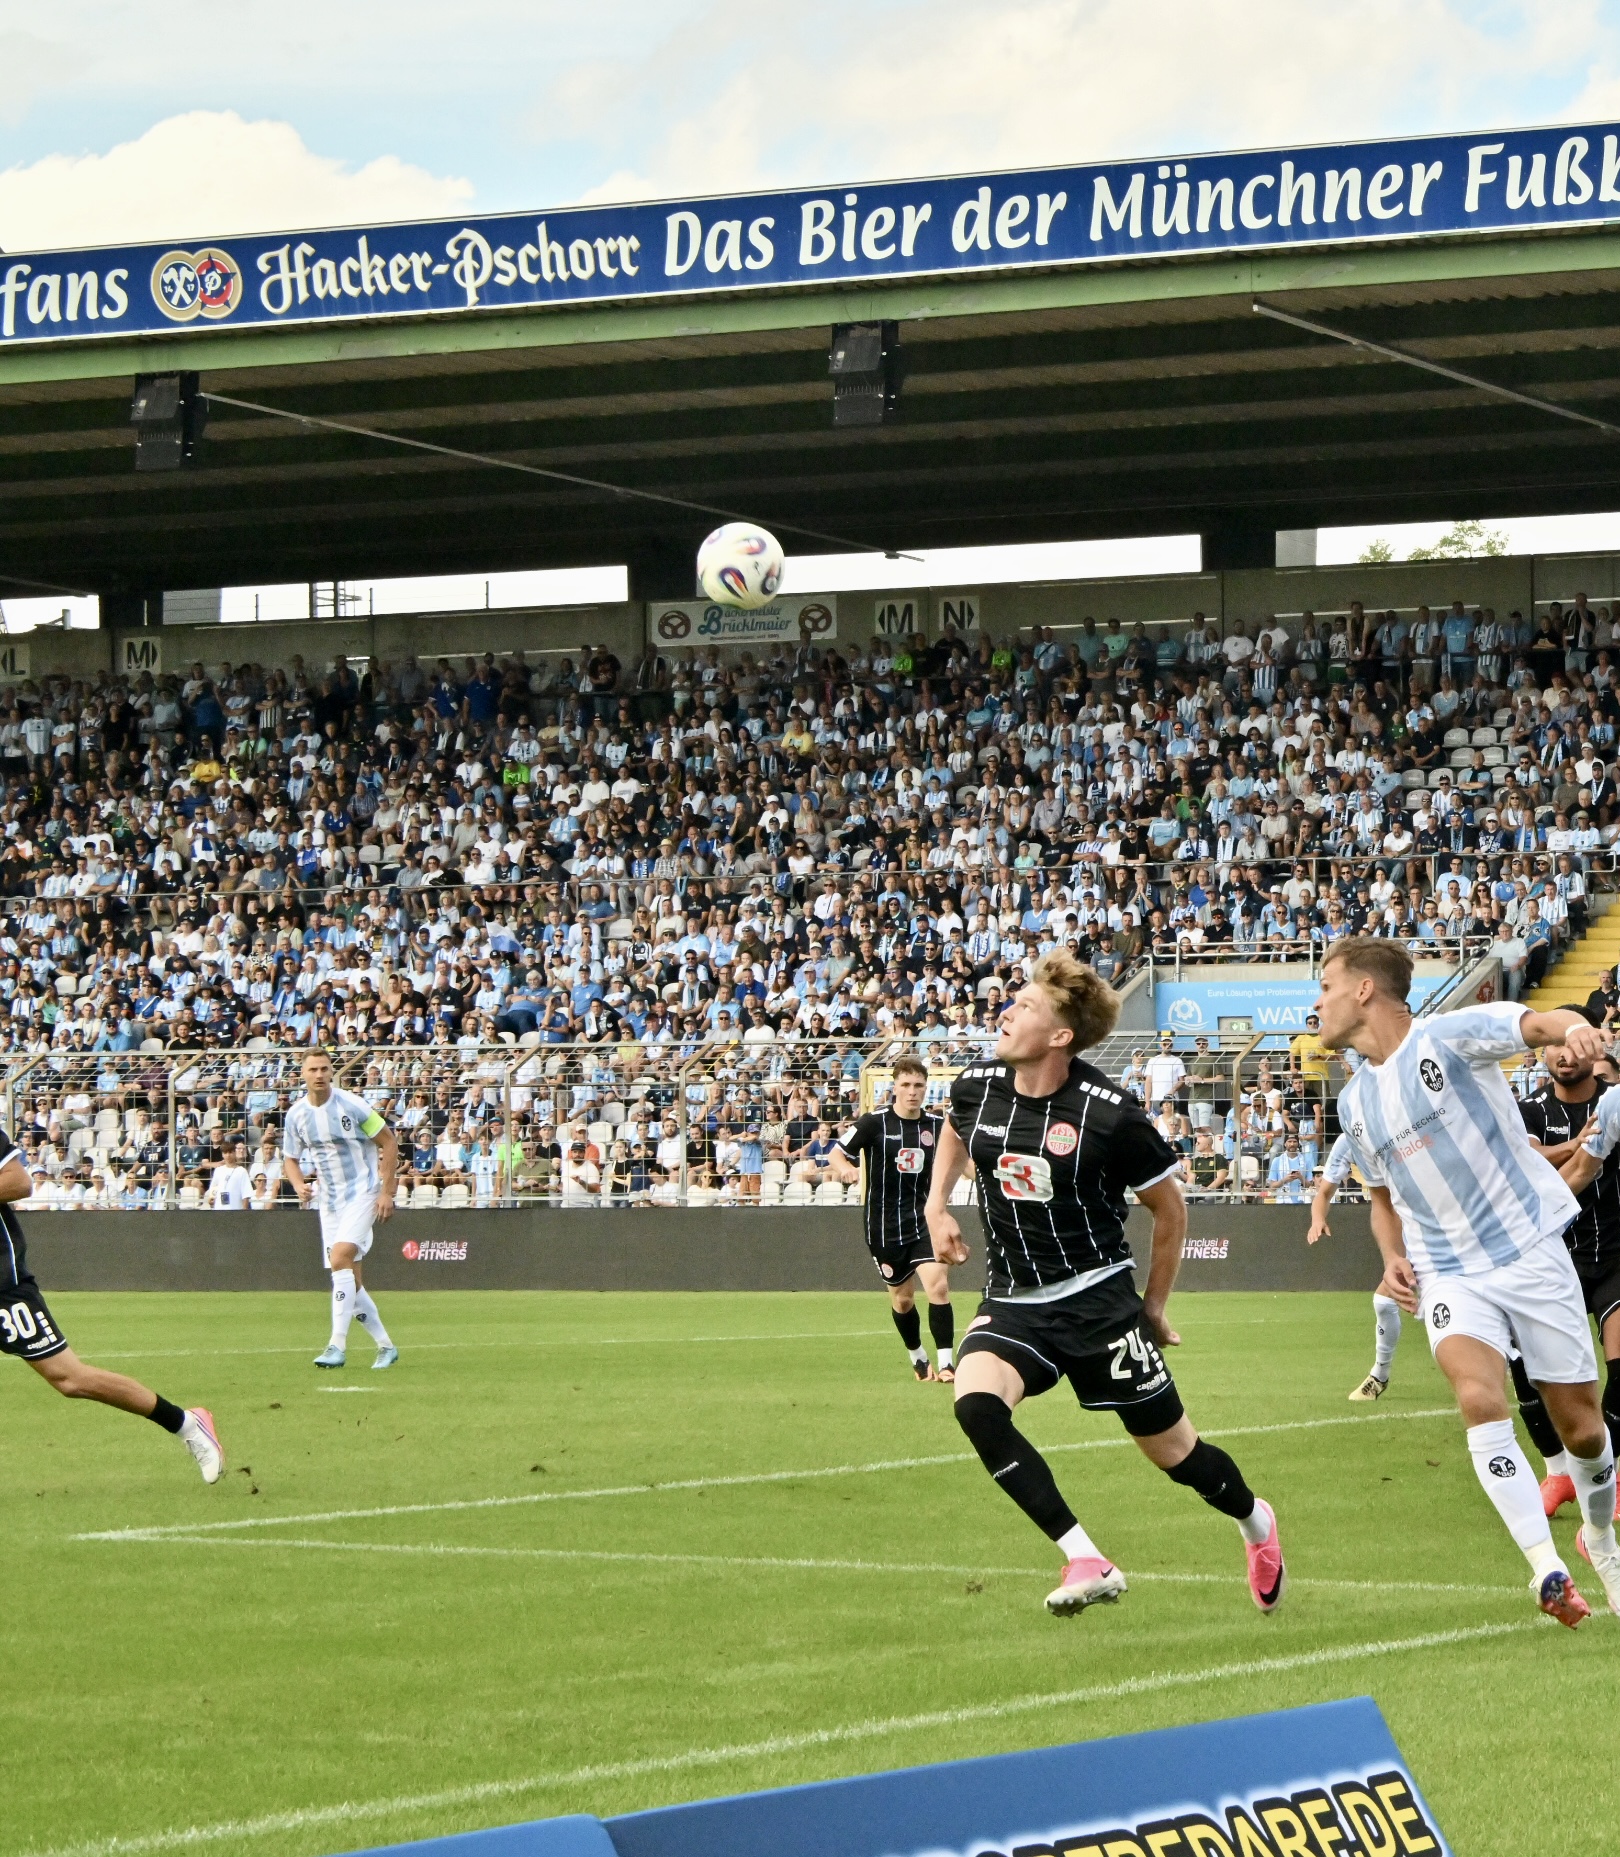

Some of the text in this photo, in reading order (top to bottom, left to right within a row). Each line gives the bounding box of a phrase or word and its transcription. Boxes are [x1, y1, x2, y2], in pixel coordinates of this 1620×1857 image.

[665, 212, 774, 276] Das
[799, 194, 931, 265] Bier
[952, 187, 1067, 253] der
[1090, 161, 1442, 242] Münchner
[257, 221, 641, 314] Hacker-Pschorr
[887, 603, 914, 634] M
[943, 601, 966, 630] N
[10, 648, 26, 675] L
[127, 641, 150, 669] M
[1207, 987, 1320, 999] Eure Lösung bei Problemen mit
[977, 1123, 1006, 1137] capelli
[1396, 1128, 1412, 1142] FÜR
[1411, 1107, 1447, 1133] SECHZIG
[1391, 1133, 1434, 1164] Dialog
[417, 1249, 467, 1260] FITNESS
[420, 1240, 430, 1248] all
[1181, 1247, 1228, 1259] ITNESS
[0, 1301, 37, 1343] 30
[1107, 1327, 1150, 1380] 24
